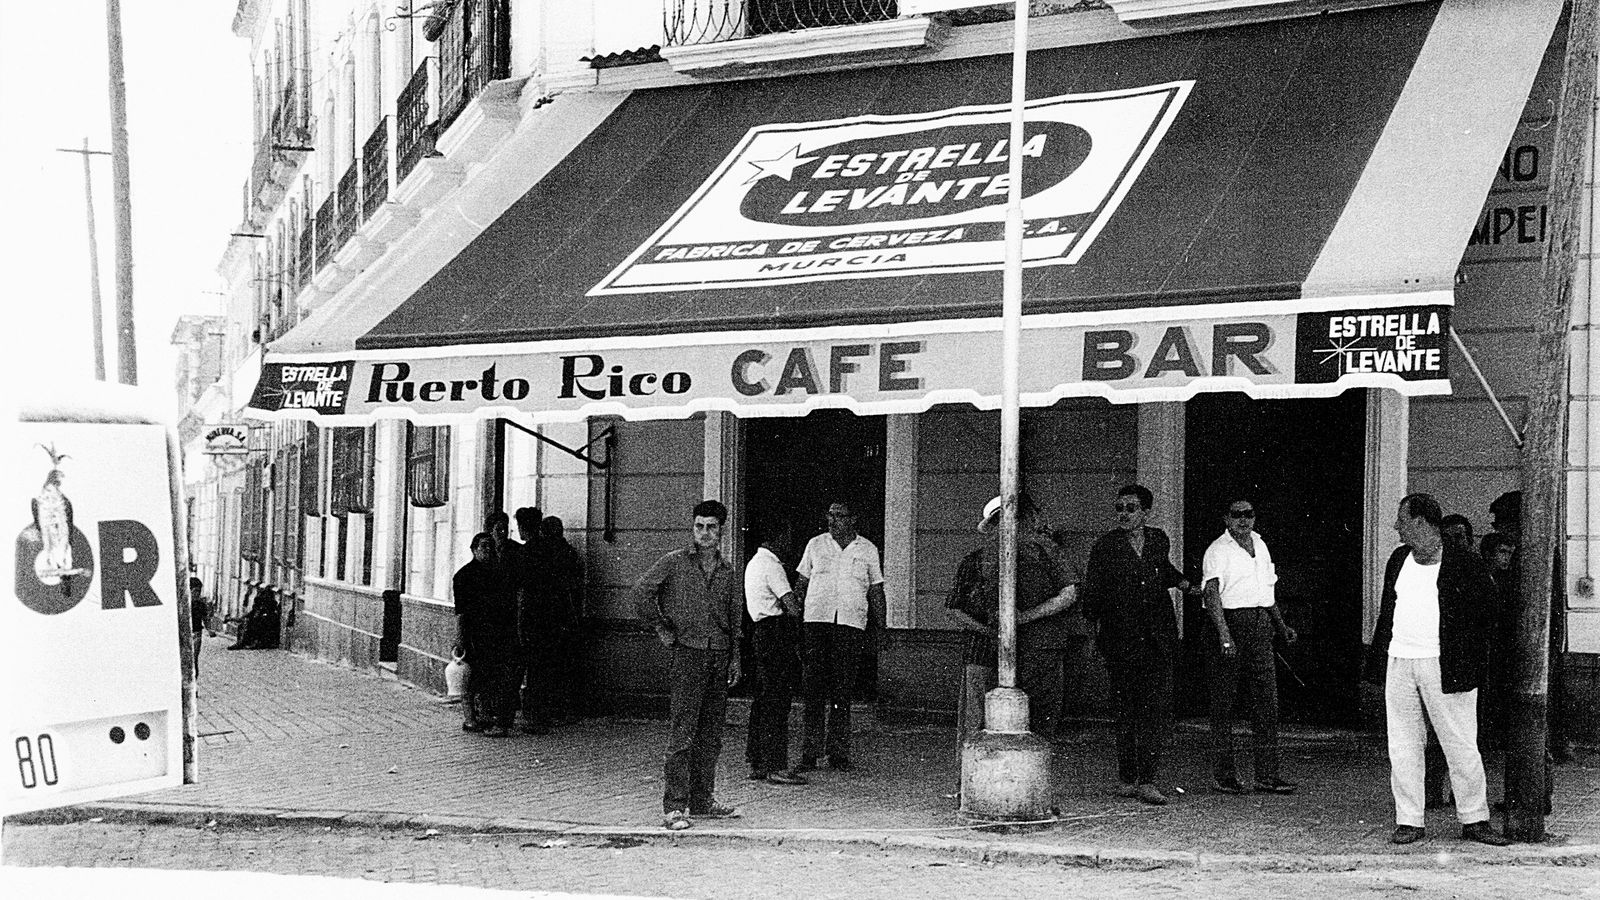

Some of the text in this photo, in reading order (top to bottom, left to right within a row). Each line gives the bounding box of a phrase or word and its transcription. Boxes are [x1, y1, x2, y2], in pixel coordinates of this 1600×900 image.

[812, 134, 1047, 178] ESTRELLA
[894, 170, 931, 183] DE
[780, 174, 1009, 214] LEVANTE
[654, 243, 769, 261] FABRICA
[778, 240, 821, 253] DE
[829, 228, 965, 249] CERVEZA
[758, 253, 906, 272] MURCIA
[1329, 312, 1440, 338] ESTRELLA
[1396, 335, 1416, 350] DE
[365, 322, 1282, 403] Puerto Rico CAFE BAR
[1346, 349, 1440, 373] LEVANTE
[282, 365, 346, 382] ESTRELLA
[317, 381, 332, 391] DE
[284, 391, 343, 407] LEVANTE
[16, 734, 58, 788] 80
